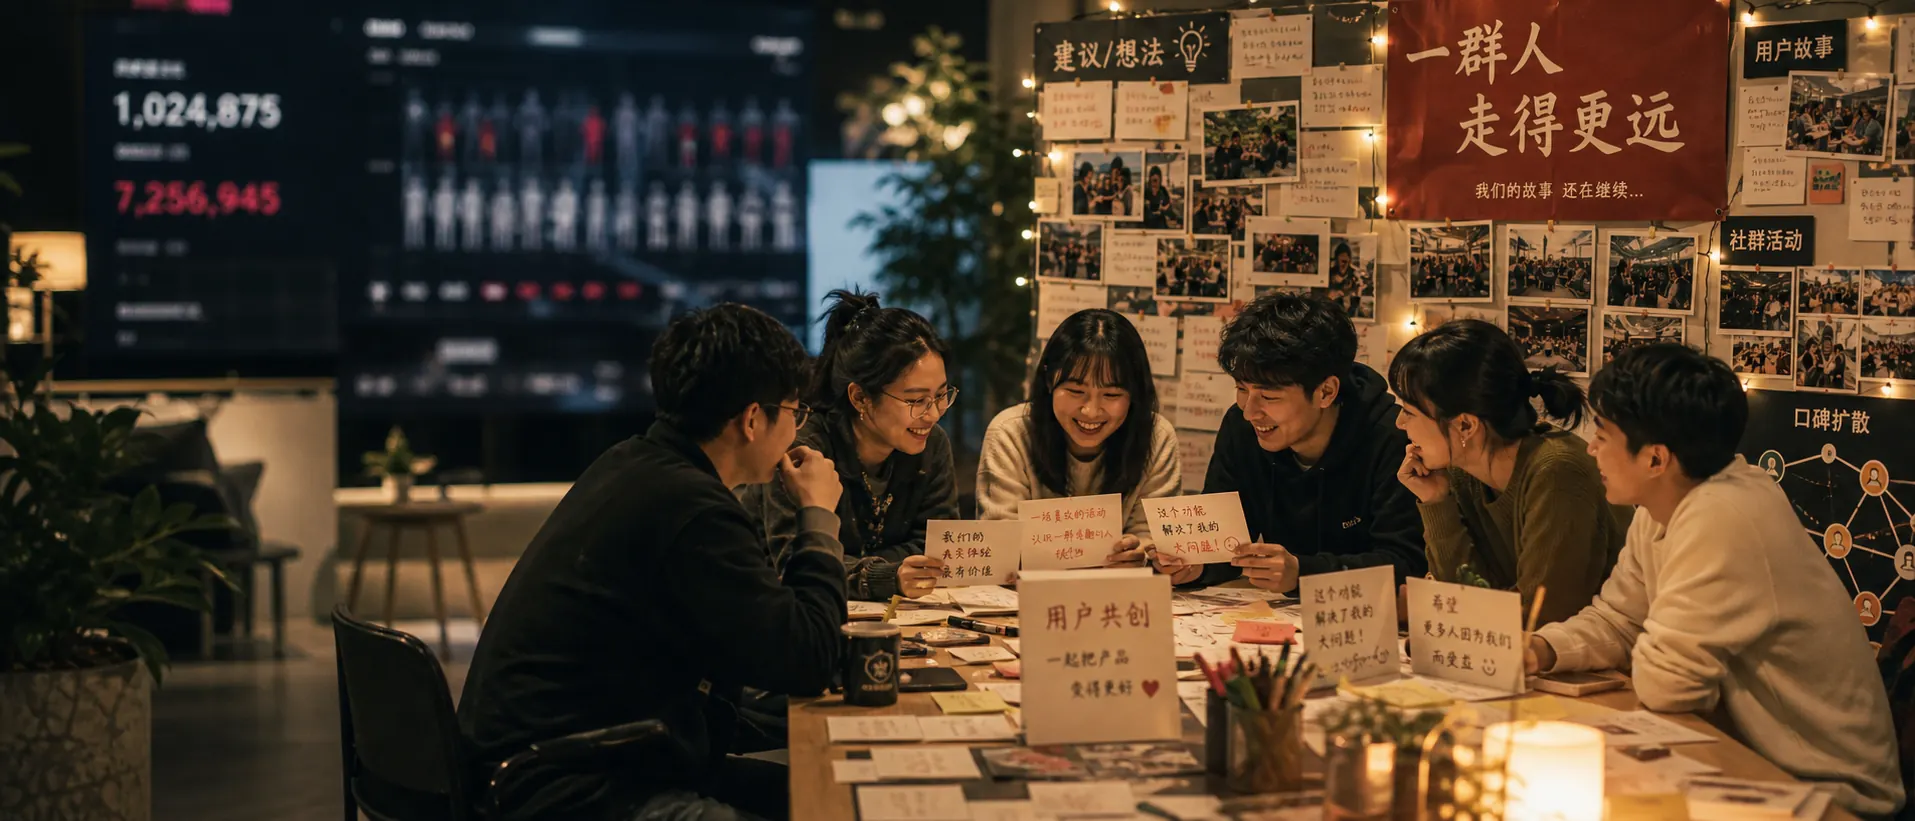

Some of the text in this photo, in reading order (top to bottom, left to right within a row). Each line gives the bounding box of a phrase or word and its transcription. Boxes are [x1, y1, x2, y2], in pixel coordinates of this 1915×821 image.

[1053, 37, 1165, 72] 建议/想法
[1406, 19, 1564, 85] 一群人
[1755, 34, 1834, 63] 用户故事
[113, 92, 282, 130] 1,024,875
[1456, 89, 1685, 157] 走得更远
[114, 180, 282, 217] 7,256,945
[1475, 181, 1553, 199] 我们的故事
[1729, 229, 1803, 252] 社群活动
[1794, 407, 1871, 435] 口碑扩散
[1046, 601, 1150, 631] 用户共创
[1432, 593, 1459, 615] 希望
[1423, 620, 1513, 650] 更多人因为我们
[1046, 648, 1130, 668] 一起把产品
[1070, 679, 1133, 699] 变得更好
